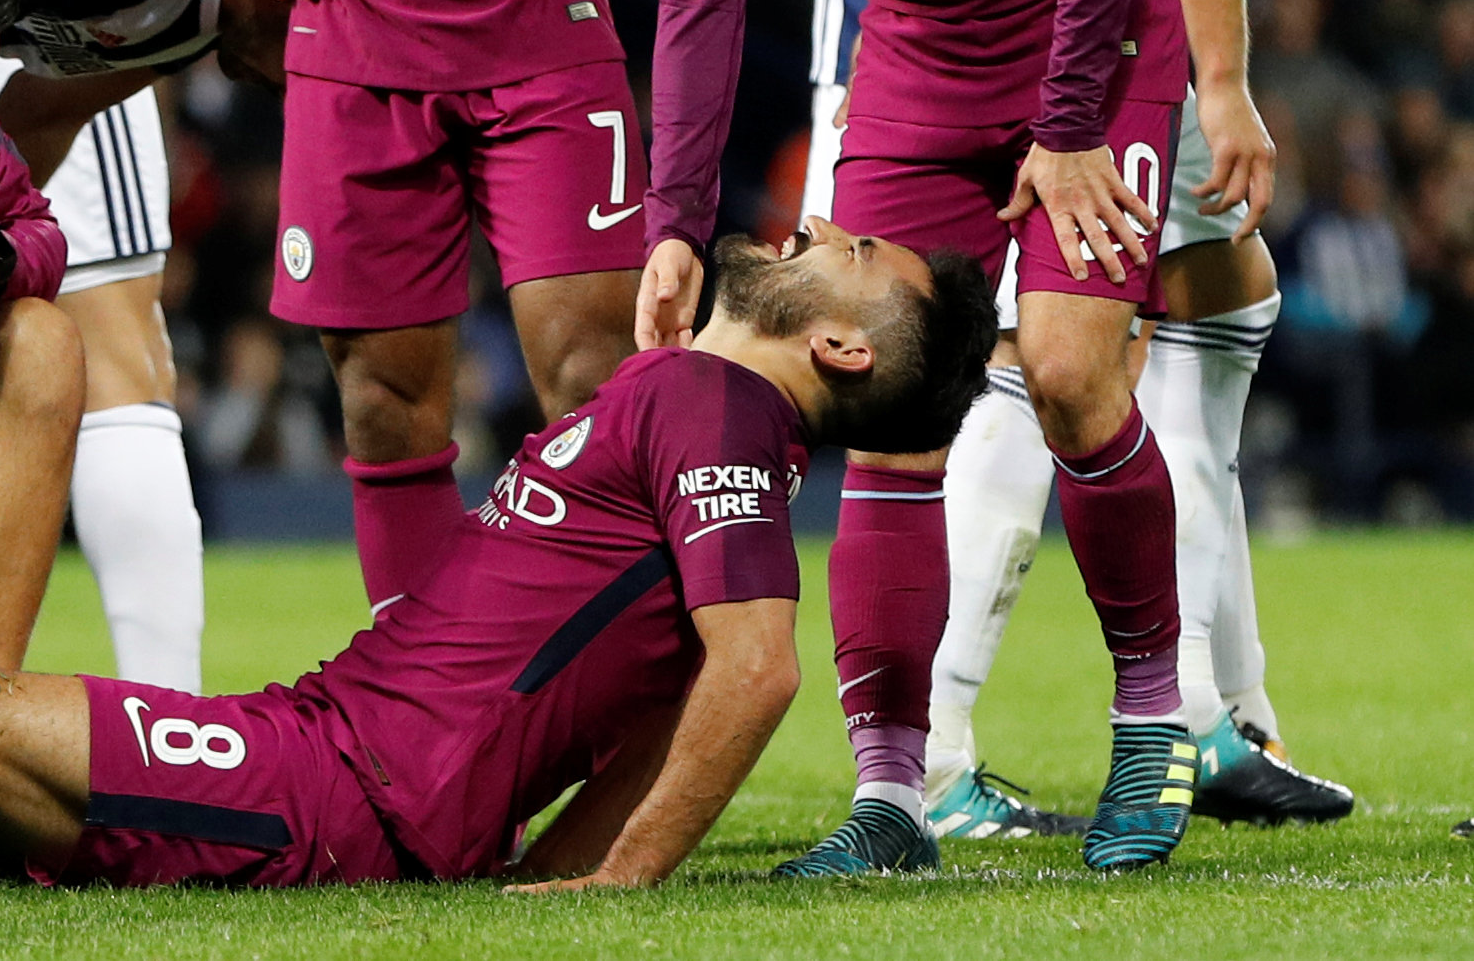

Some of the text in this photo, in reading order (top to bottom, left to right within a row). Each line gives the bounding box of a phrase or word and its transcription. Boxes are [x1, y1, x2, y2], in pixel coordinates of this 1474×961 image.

[587, 110, 626, 205] 7
[677, 465, 771, 497] NEXEN
[691, 492, 761, 522] TIRE
[149, 717, 248, 770] 8
